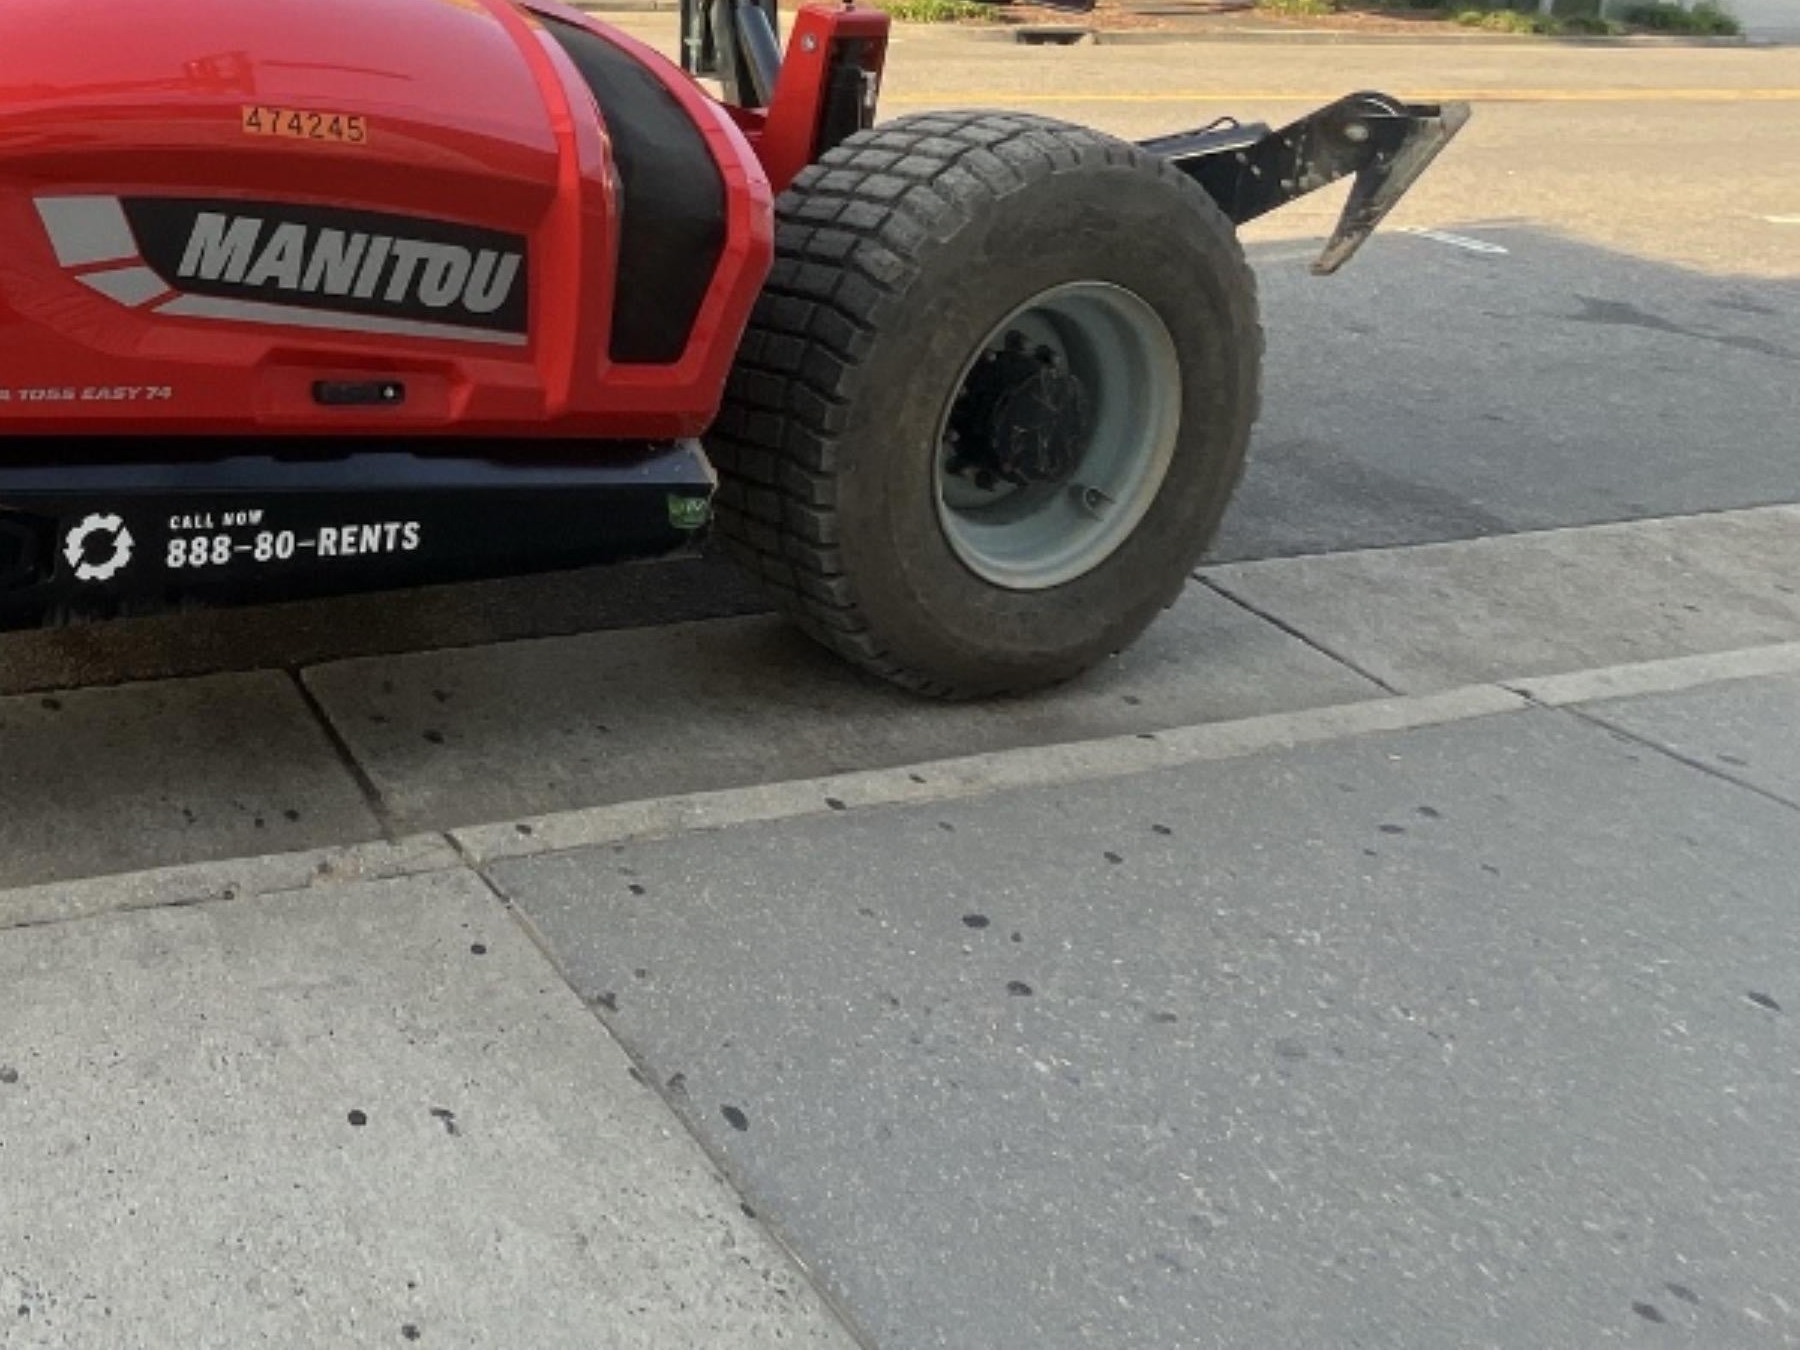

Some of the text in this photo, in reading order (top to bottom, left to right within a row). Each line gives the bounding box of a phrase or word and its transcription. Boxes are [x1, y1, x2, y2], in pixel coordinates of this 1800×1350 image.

[245, 105, 365, 143] 474245
[176, 211, 523, 314] MANITOU
[80, 386, 142, 401] EASY
[145, 385, 173, 400] 74
[169, 508, 265, 530] CALL NOW
[166, 520, 422, 569] 888-80-RENTS
